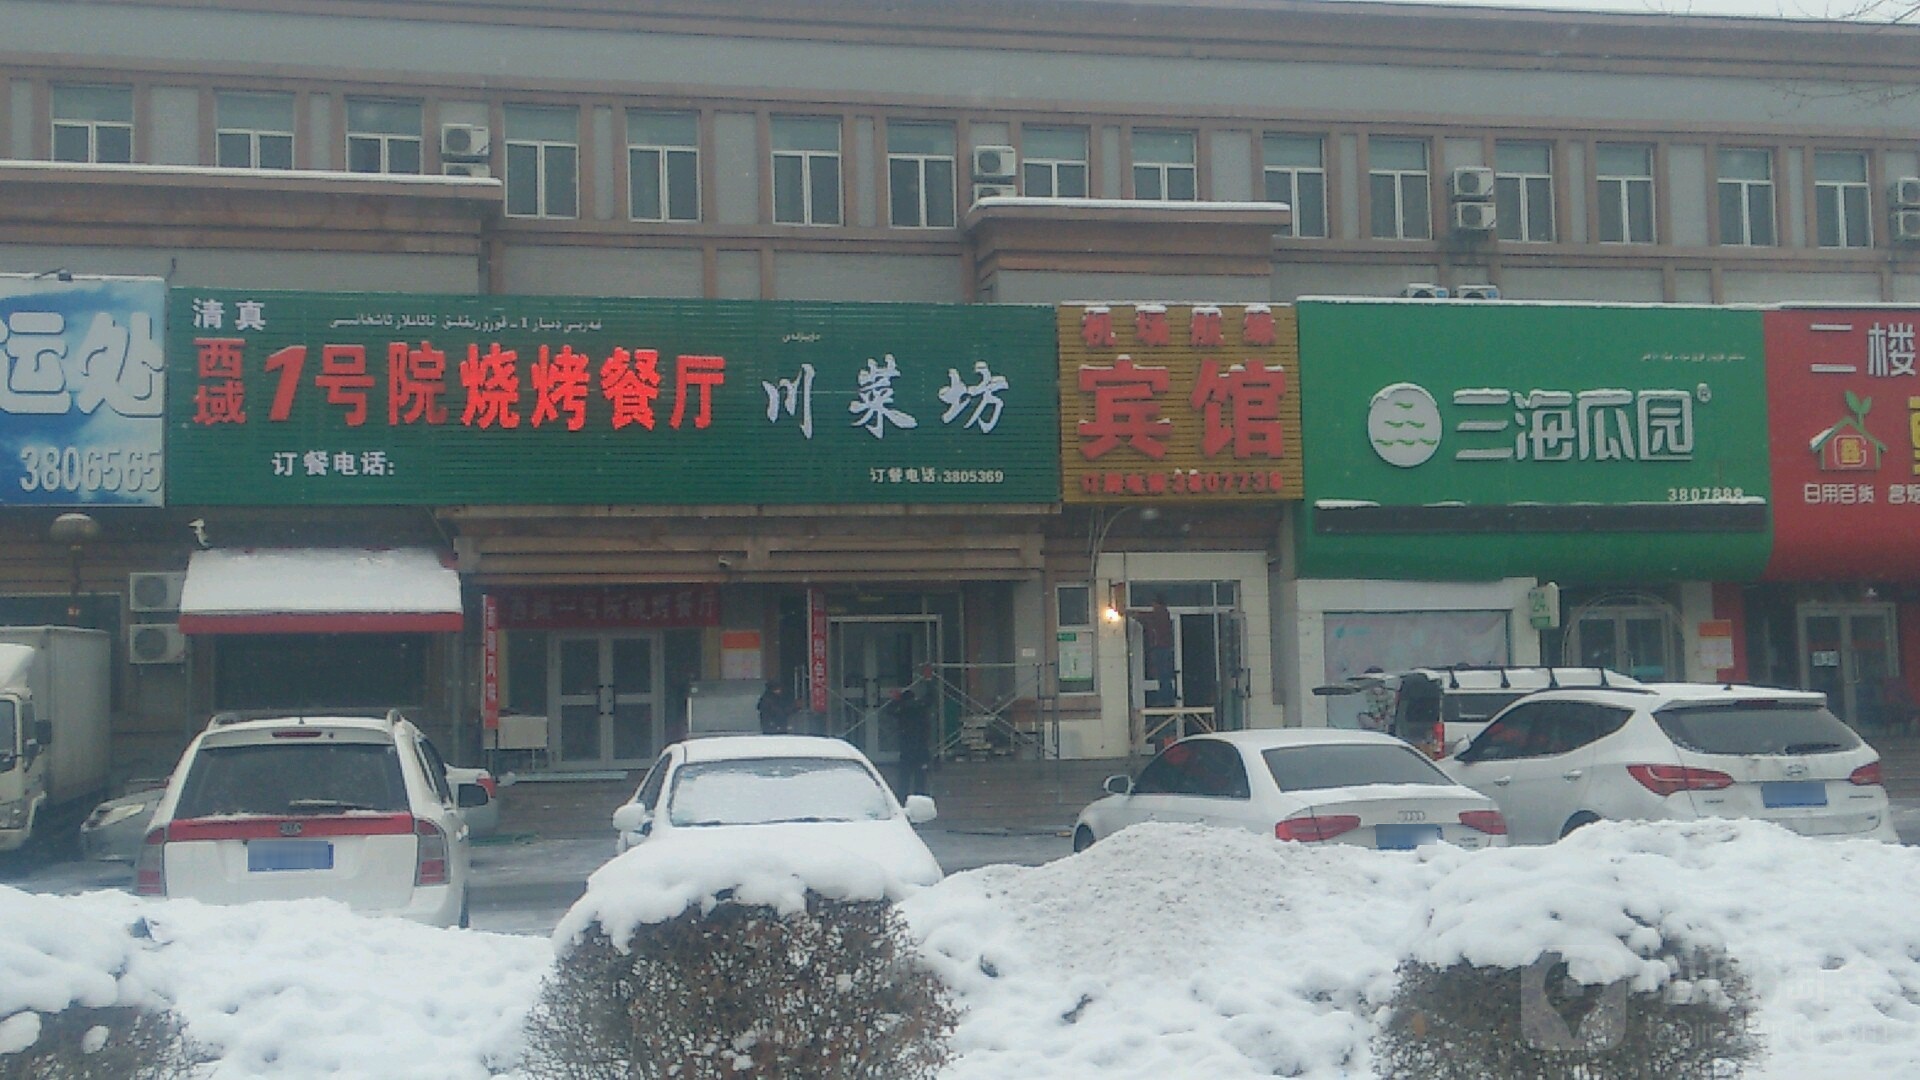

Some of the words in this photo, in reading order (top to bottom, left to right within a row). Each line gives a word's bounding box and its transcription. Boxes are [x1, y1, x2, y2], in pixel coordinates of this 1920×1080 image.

[192, 297, 266, 330] 清真
[1810, 321, 1916, 377] 二楼
[0, 312, 163, 418] 运处
[193, 337, 246, 425] 西域
[264, 341, 726, 432] 1号院烧烤餐厅
[762, 353, 1008, 440] 川菜坊
[1077, 355, 1286, 460] 宾馆
[1453, 388, 1694, 461] 三海瓜园
[19, 447, 163, 492] 3806565
[1804, 483, 1875, 504] 日用百货
